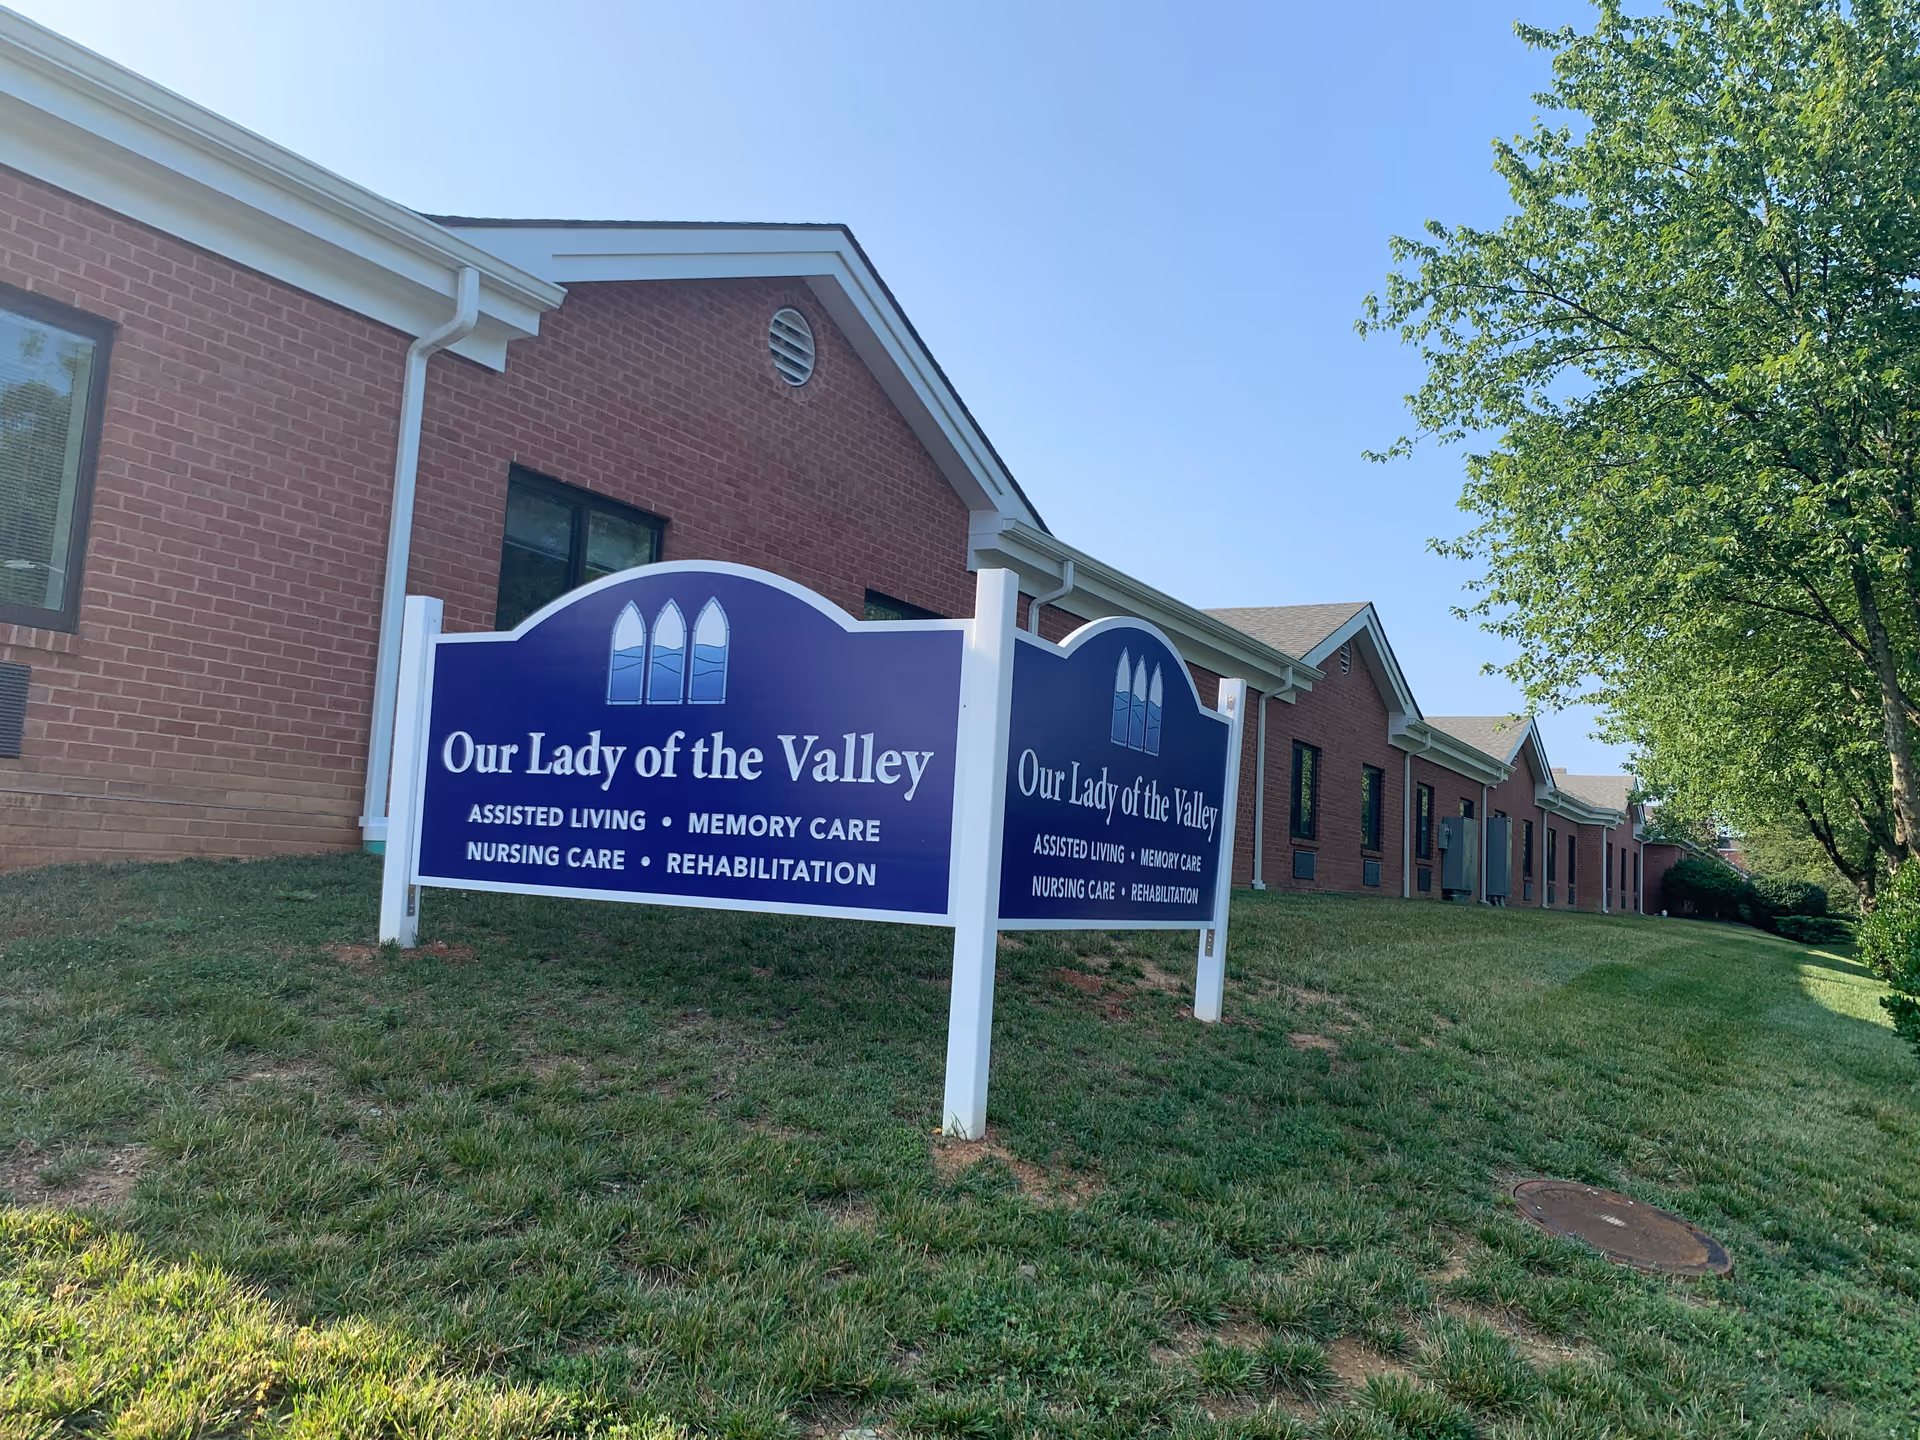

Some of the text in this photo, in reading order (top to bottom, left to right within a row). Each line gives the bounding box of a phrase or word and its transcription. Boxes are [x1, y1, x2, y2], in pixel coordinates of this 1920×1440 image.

[442, 729, 935, 802] Our Lady of the Valley
[1017, 748, 1219, 843] Our Lady of the Valley
[467, 803, 881, 842] ASSISTED LIVING MEMORY CARE
[466, 841, 877, 886] NURSING CARE REHABILITATION
[1033, 833, 1202, 873] ASSISTED LIVING MEMORY CARE
[1031, 875, 1199, 905] NURSING CARE REHABILITATION
